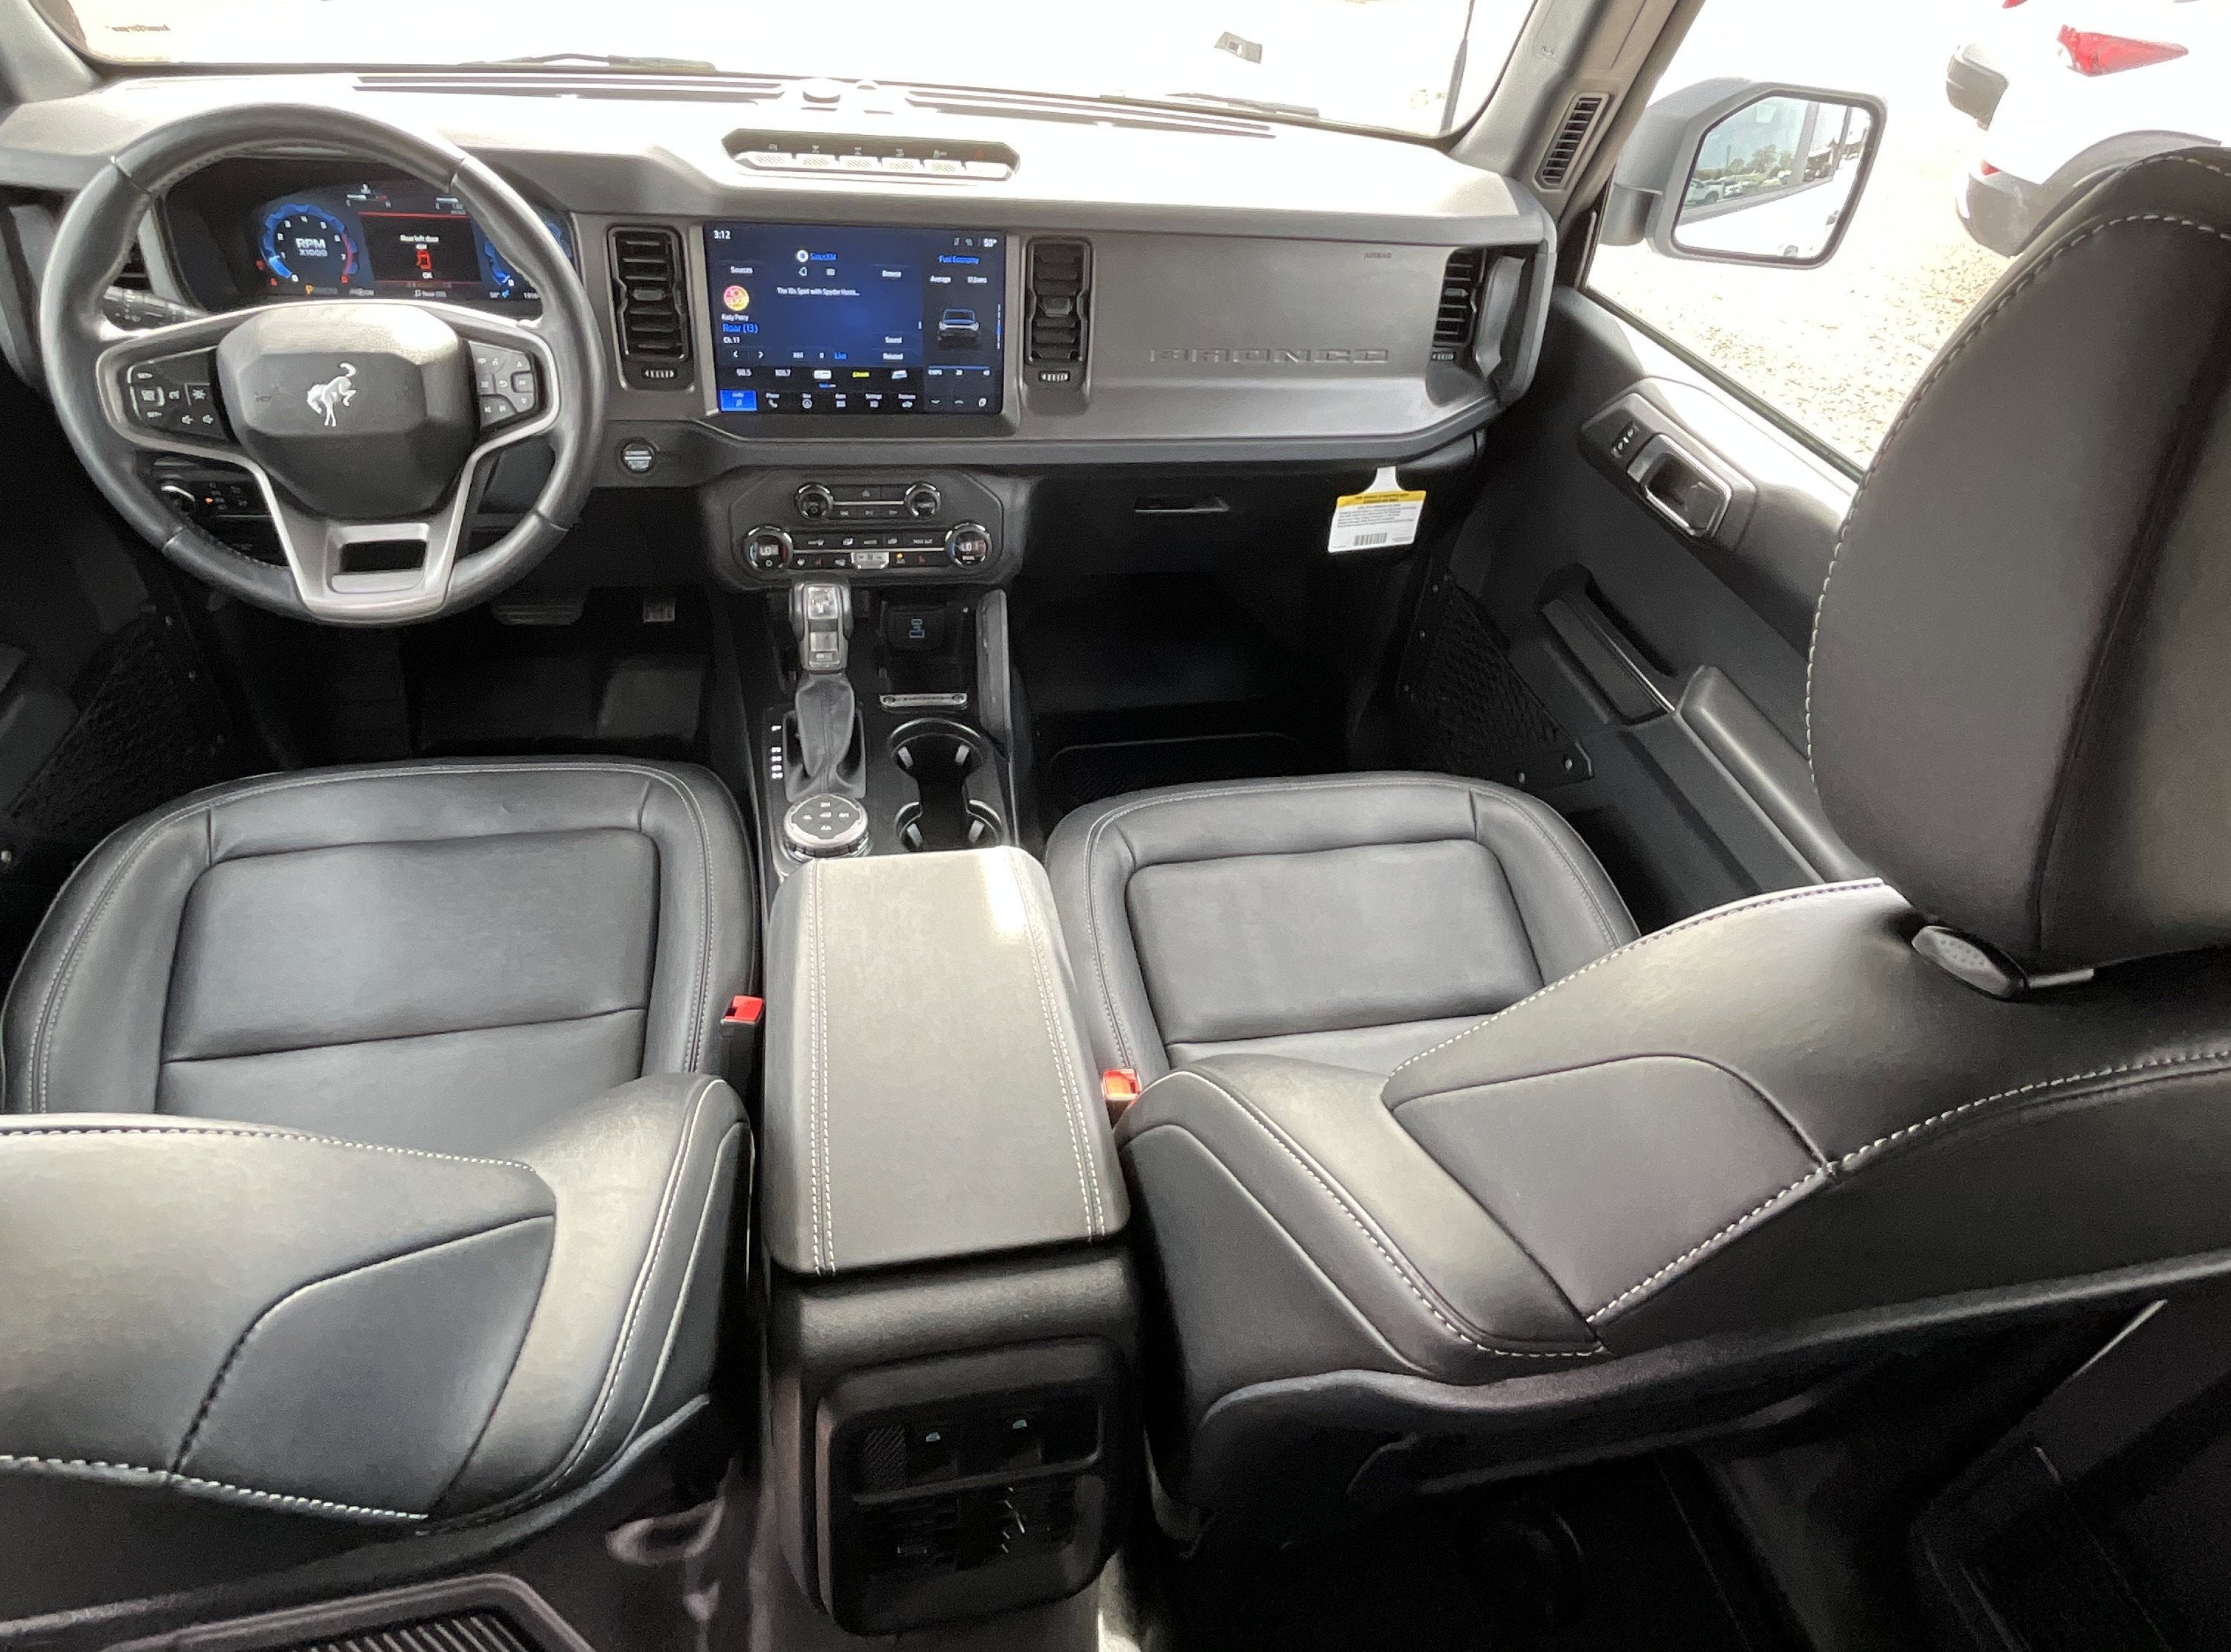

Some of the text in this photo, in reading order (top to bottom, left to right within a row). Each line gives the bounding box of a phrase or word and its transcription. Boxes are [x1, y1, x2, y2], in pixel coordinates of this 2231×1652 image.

[713, 230, 731, 239] 3:12
[295, 238, 326, 249] RPM
[722, 323, 758, 333] Roar (13)
[1149, 348, 1388, 363] BRONCO
